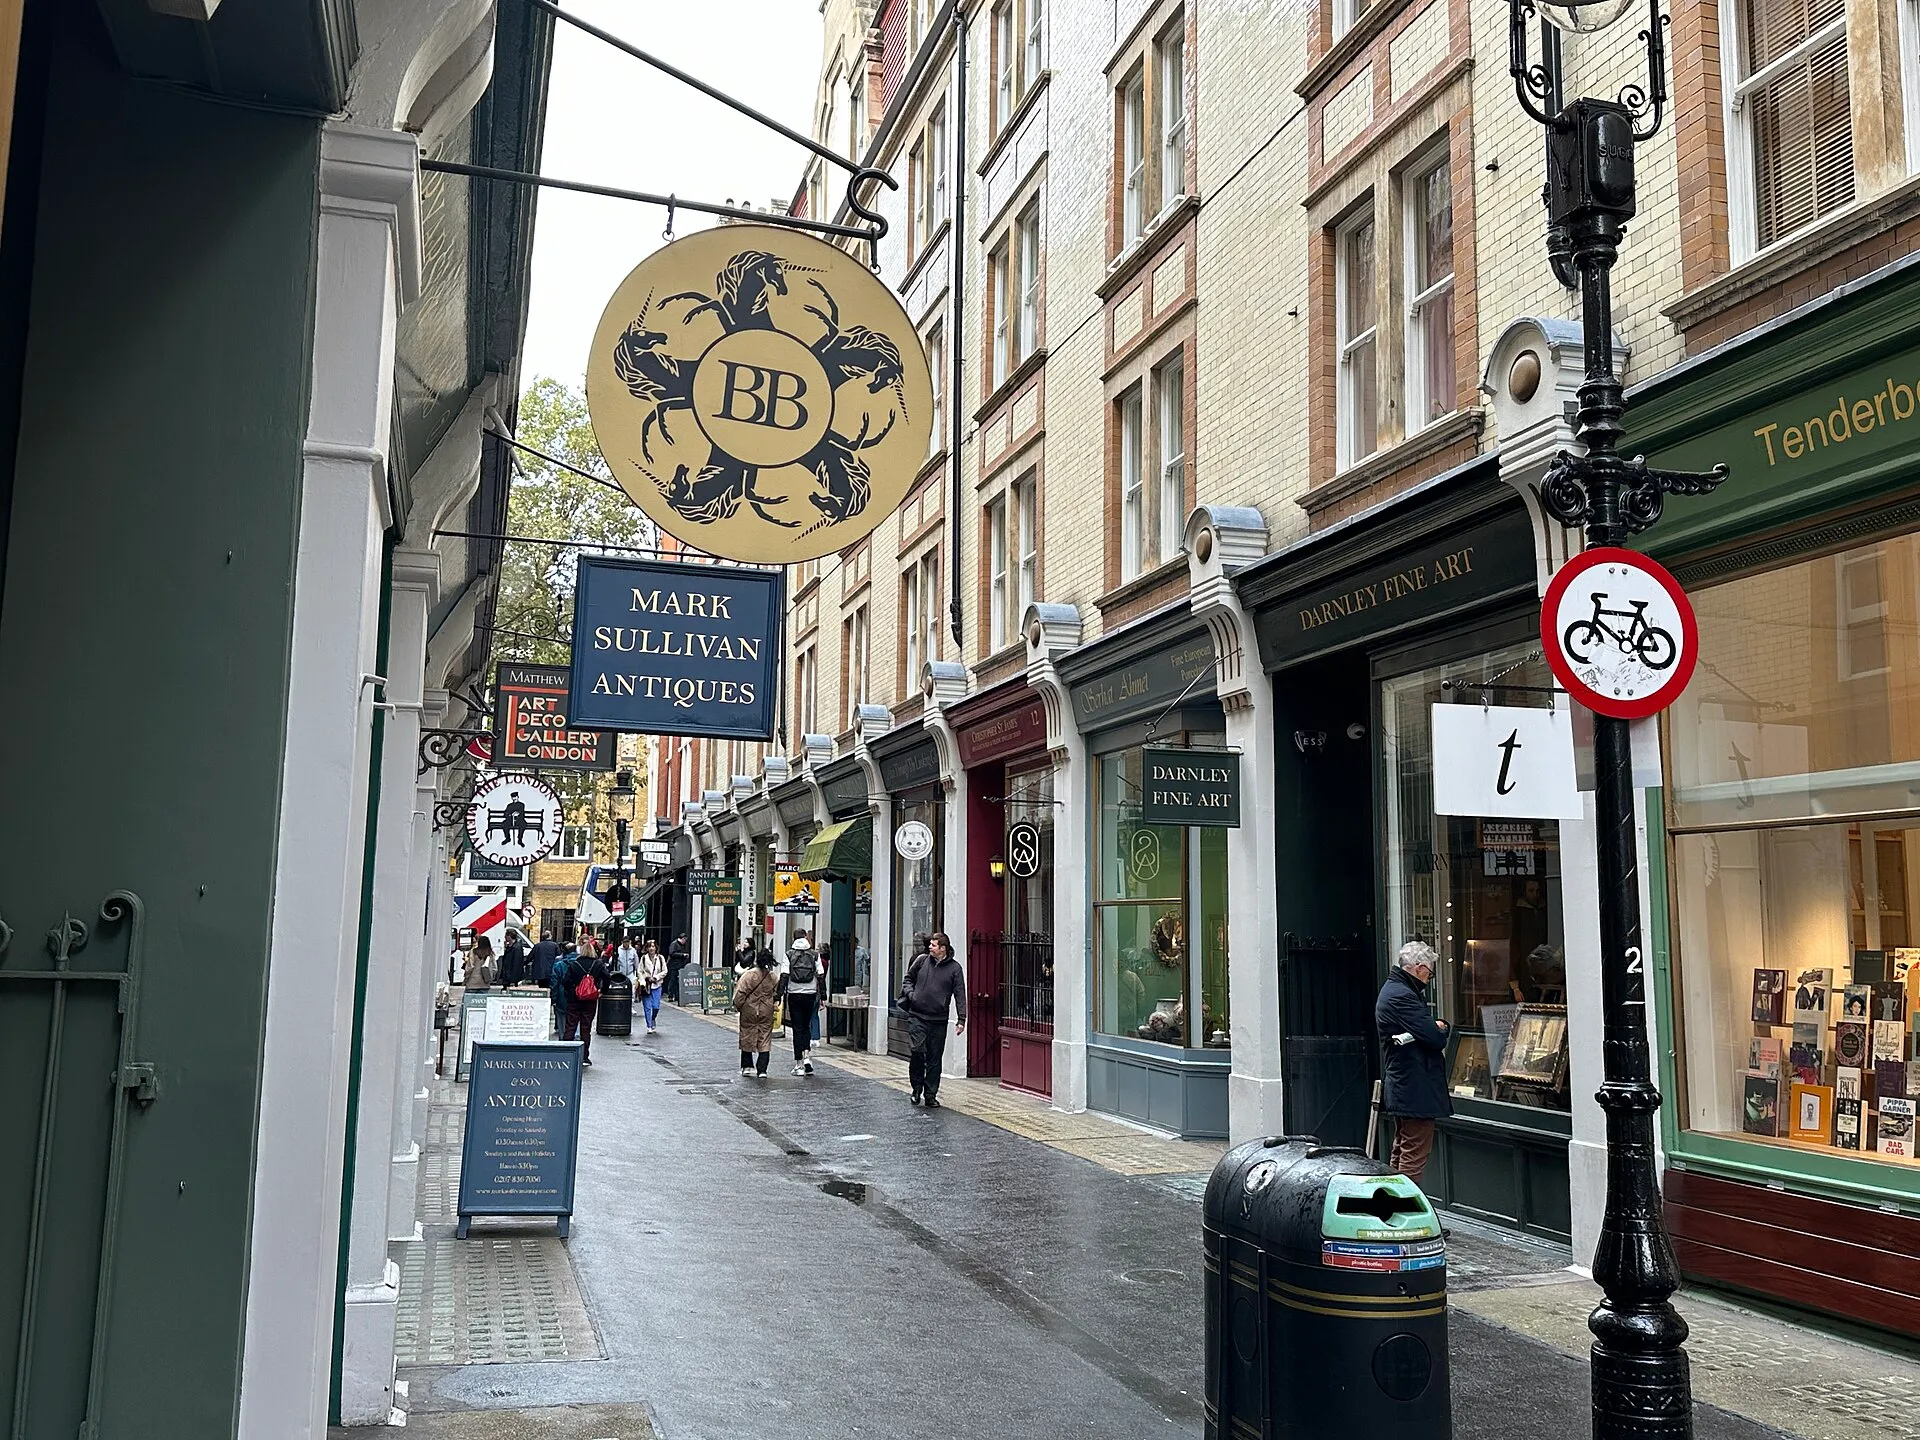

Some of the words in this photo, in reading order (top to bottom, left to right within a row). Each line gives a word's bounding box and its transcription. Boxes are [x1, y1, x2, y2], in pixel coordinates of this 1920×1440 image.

[712, 359, 809, 431] BB
[1753, 378, 1920, 466] Tenderb
[1298, 584, 1379, 631] DARNLEY
[1382, 565, 1428, 602] FINE
[1433, 547, 1474, 585] ART
[629, 589, 733, 620] MARK
[594, 626, 761, 661] SULLIVAN
[509, 670, 565, 685] MATTHEW
[591, 673, 756, 707] ANTIQUES
[518, 697, 558, 711] ART
[518, 711, 566, 728] DECO
[1030, 710, 1040, 726] 12
[516, 727, 600, 746] GALLERY
[1495, 728, 1522, 796] t
[1153, 766, 1232, 783] DARNLEY
[476, 780, 501, 798] THE
[505, 775, 555, 801] LONDON
[1153, 791, 1193, 806] FINE
[1197, 793, 1232, 809] ART
[466, 804, 485, 853] MEDAL
[489, 840, 552, 866] COMPANY
[552, 808, 563, 835] LTD
[1624, 946, 1643, 974] 2
[484, 1060, 515, 1069] MARK
[517, 1061, 570, 1070] SULLIVAN
[510, 1078, 518, 1087] &
[519, 1077, 541, 1086] SON
[484, 1094, 566, 1109] ANTIQUES
[1882, 1104, 1912, 1114] GARNER
[1886, 1098, 1908, 1107] PIPPA
[1885, 1147, 1905, 1156] CARS
[1888, 1140, 1903, 1149] BAD
[1366, 1230, 1382, 1238] Help
